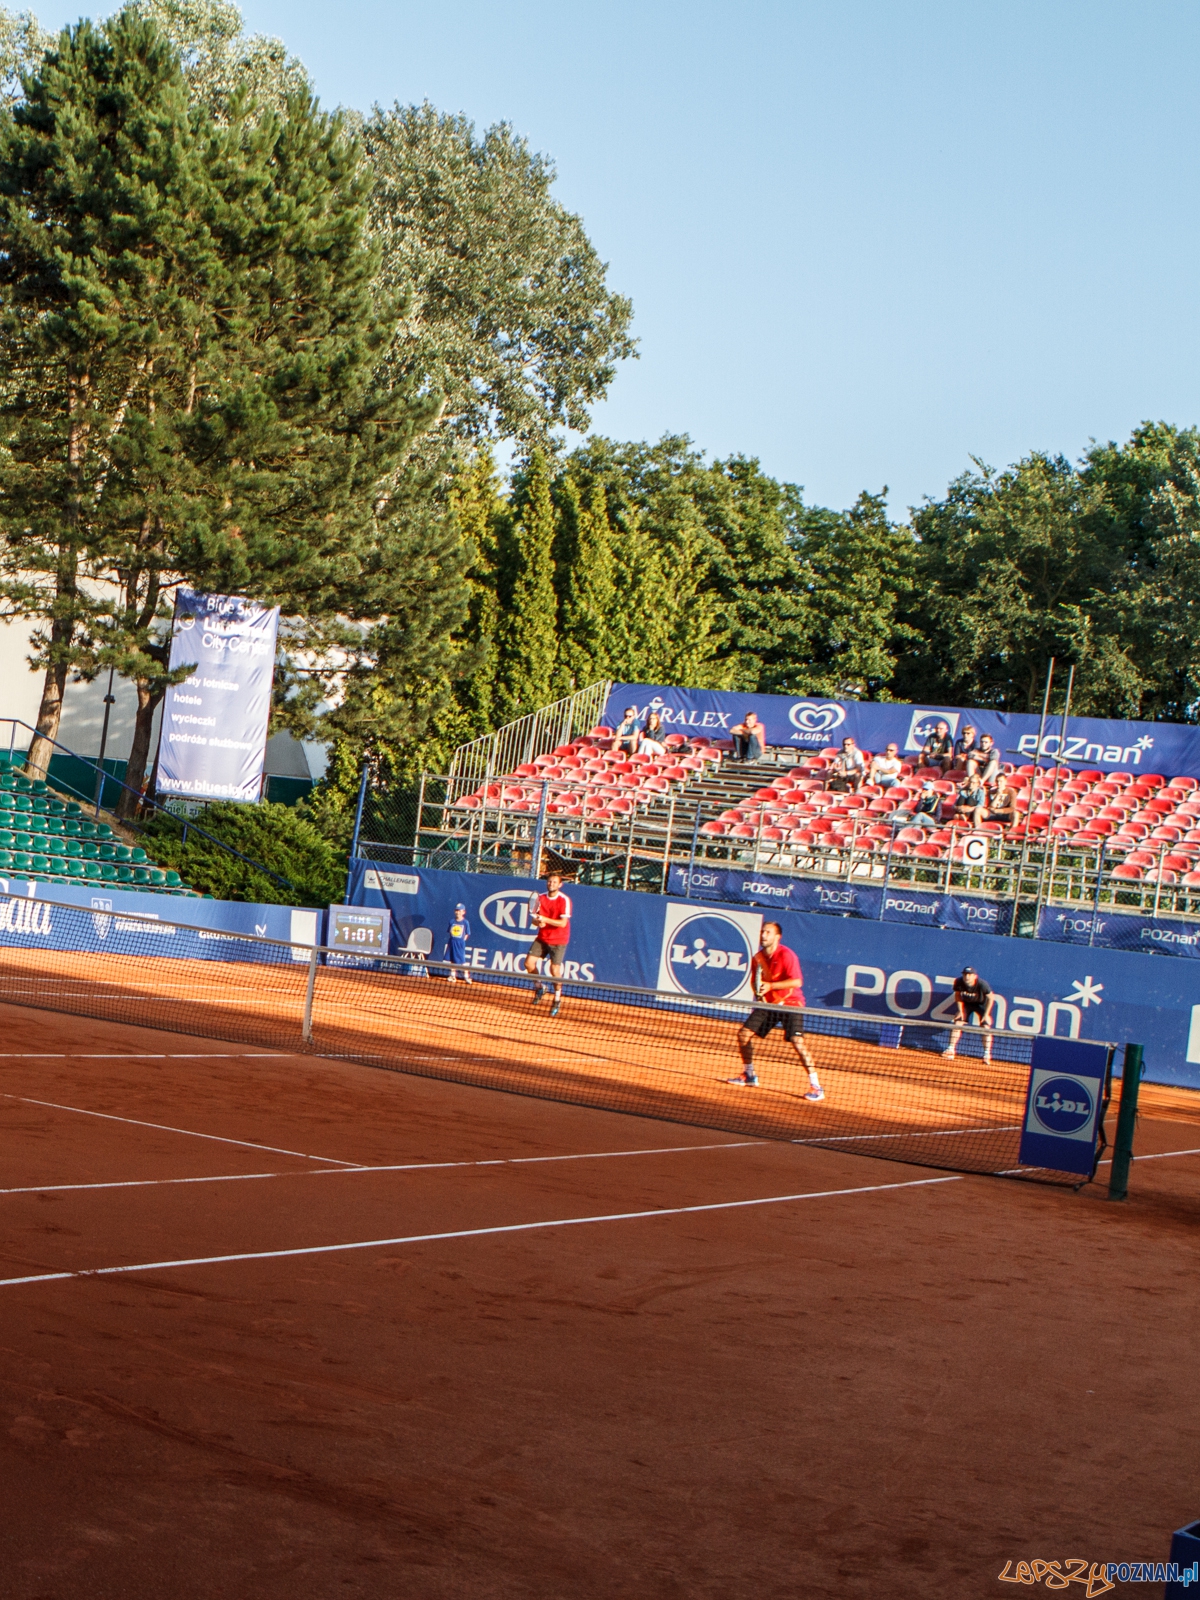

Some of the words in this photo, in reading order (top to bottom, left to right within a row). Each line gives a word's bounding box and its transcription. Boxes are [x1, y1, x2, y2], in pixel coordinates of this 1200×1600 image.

[206, 597, 235, 615] Blue
[202, 633, 227, 652] City
[203, 677, 240, 692] lotnicze
[173, 692, 202, 706] hotele
[171, 712, 216, 727] wycieczki
[790, 731, 830, 743] ALGIDA
[965, 839, 984, 860] C
[349, 914, 371, 924] TIME
[342, 926, 374, 943] 1:01
